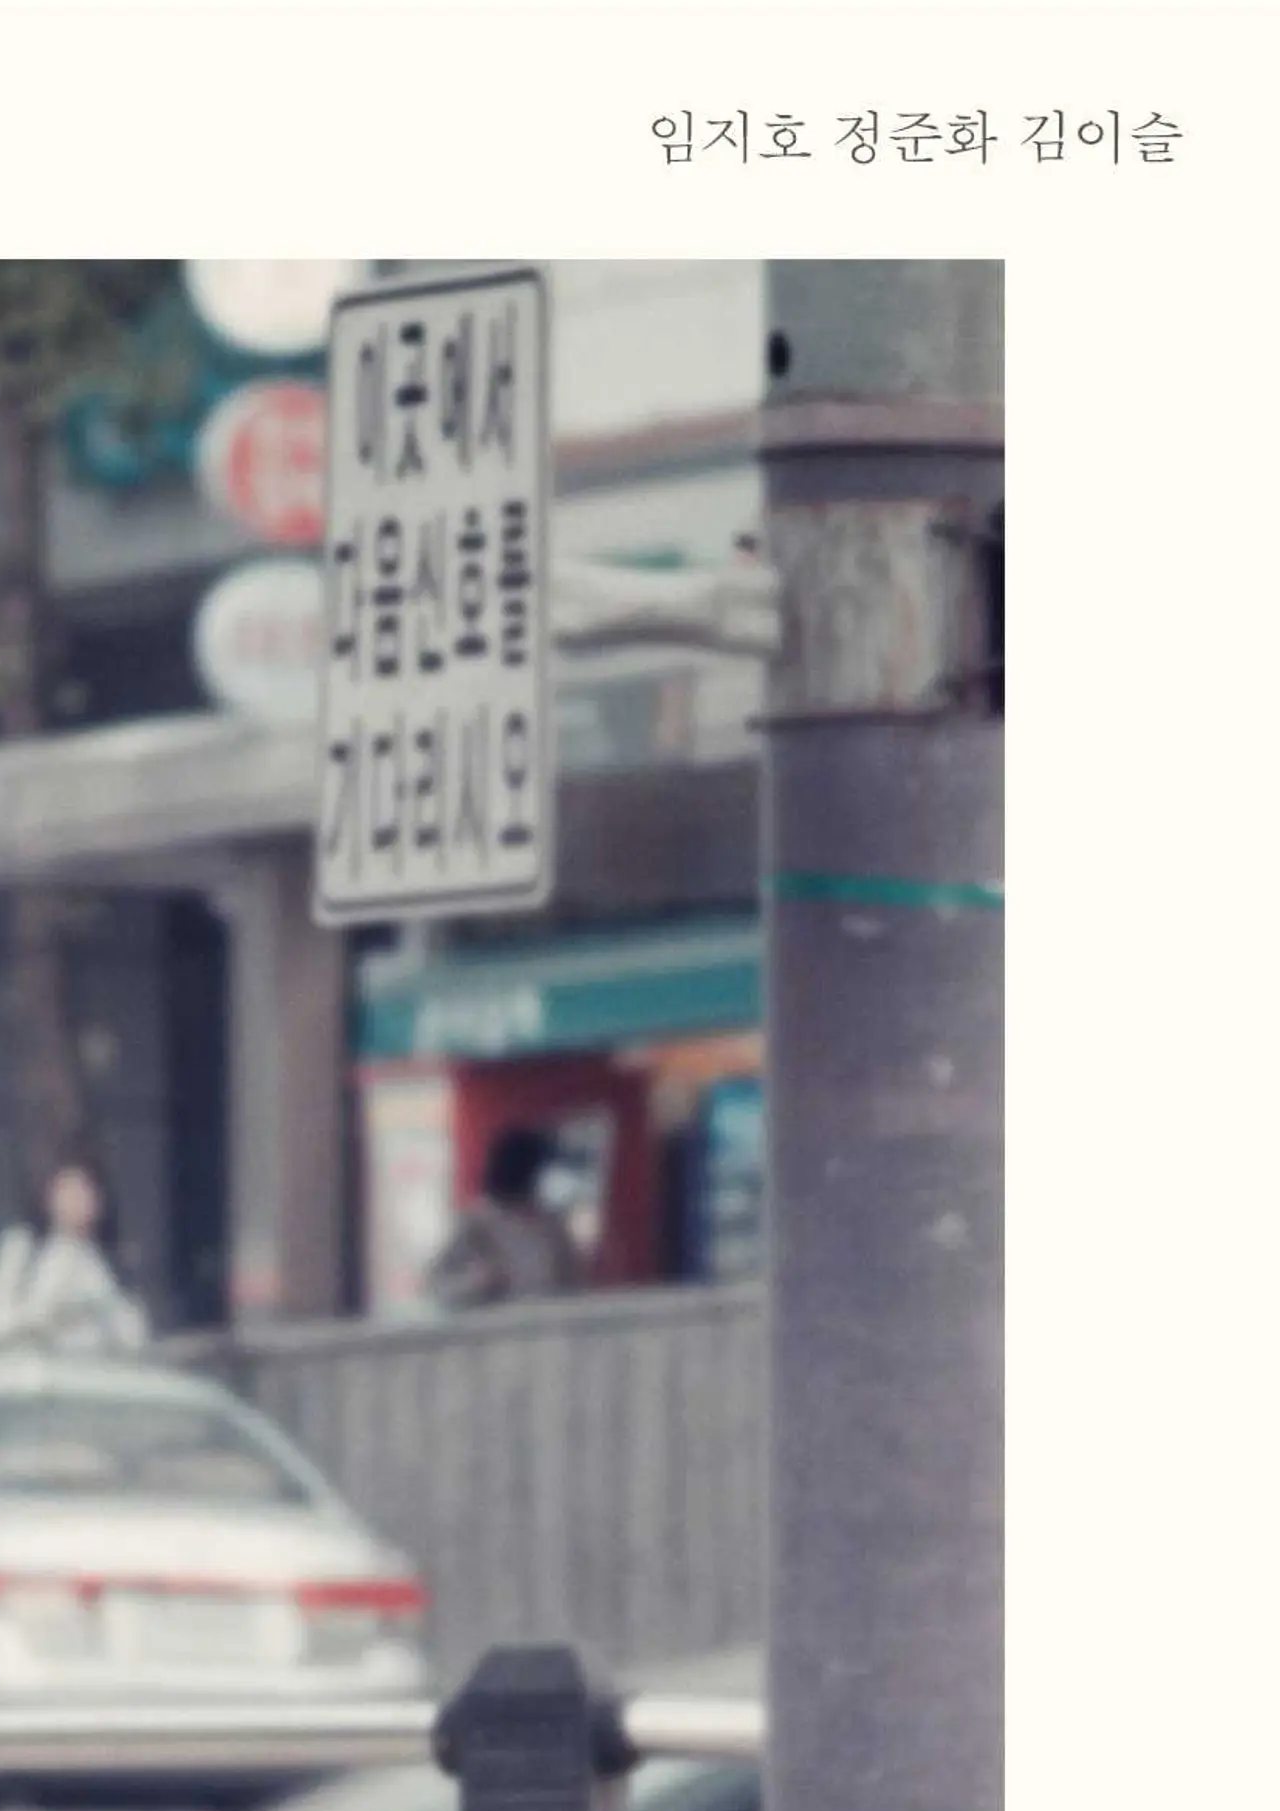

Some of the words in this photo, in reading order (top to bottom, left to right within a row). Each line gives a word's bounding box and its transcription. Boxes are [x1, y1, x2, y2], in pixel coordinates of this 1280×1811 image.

[652, 109, 813, 166] 임지호
[835, 109, 999, 166] 정준화
[1021, 109, 1184, 166] 김이슬
[355, 305, 518, 486] 이곳에서
[328, 702, 534, 880] 기다리시오
